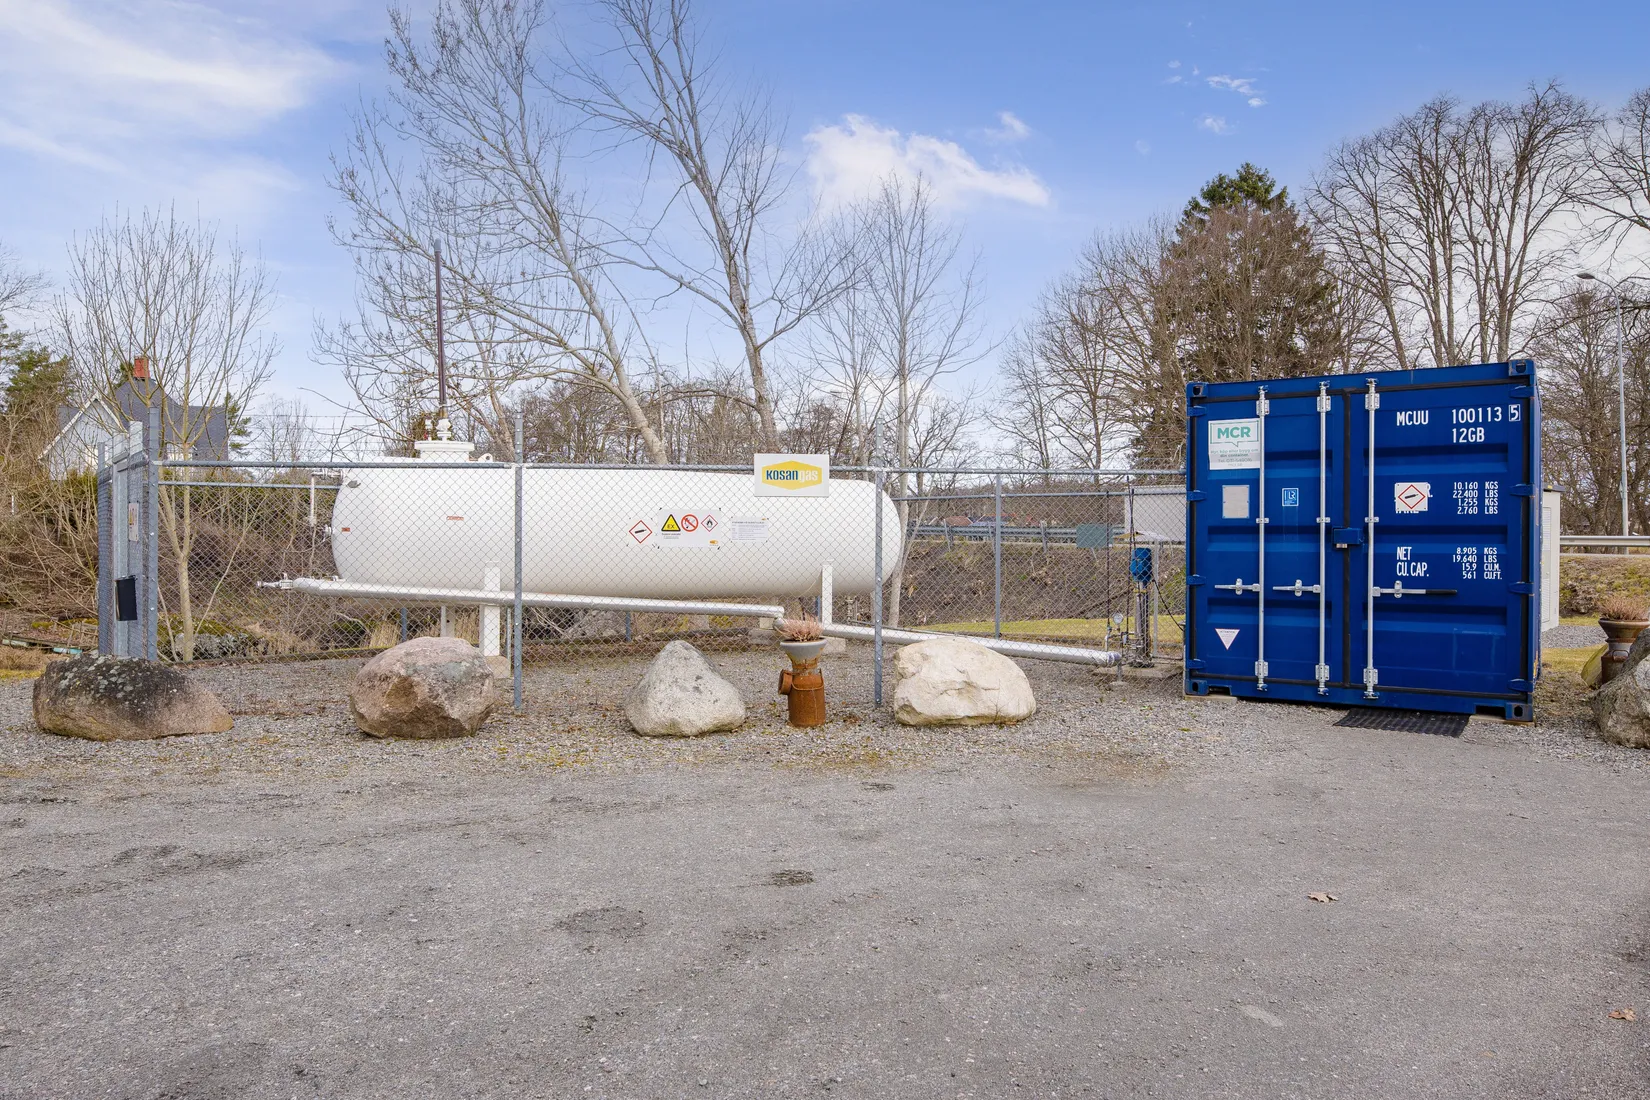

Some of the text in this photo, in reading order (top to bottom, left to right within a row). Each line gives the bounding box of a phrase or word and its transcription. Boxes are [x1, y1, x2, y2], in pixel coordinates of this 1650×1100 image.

[1396, 405, 1520, 426] MCUU 100113 5
[1217, 426, 1251, 439] MCR
[1452, 427, 1485, 443] 12GB
[1453, 481, 1499, 490] 10.160 KGS
[1452, 489, 1499, 499] 22.400 LBS
[1458, 498, 1499, 507] 1.255 KGS
[1457, 506, 1499, 515] 2.760 LBS
[1396, 546, 1412, 561] NET
[1456, 546, 1498, 555] 8.905 KGS
[1452, 554, 1498, 563] 19.640 LBS
[1396, 561, 1430, 577] CU. CAP.
[1462, 562, 1477, 571] 15.9
[1462, 570, 1476, 580] 561
